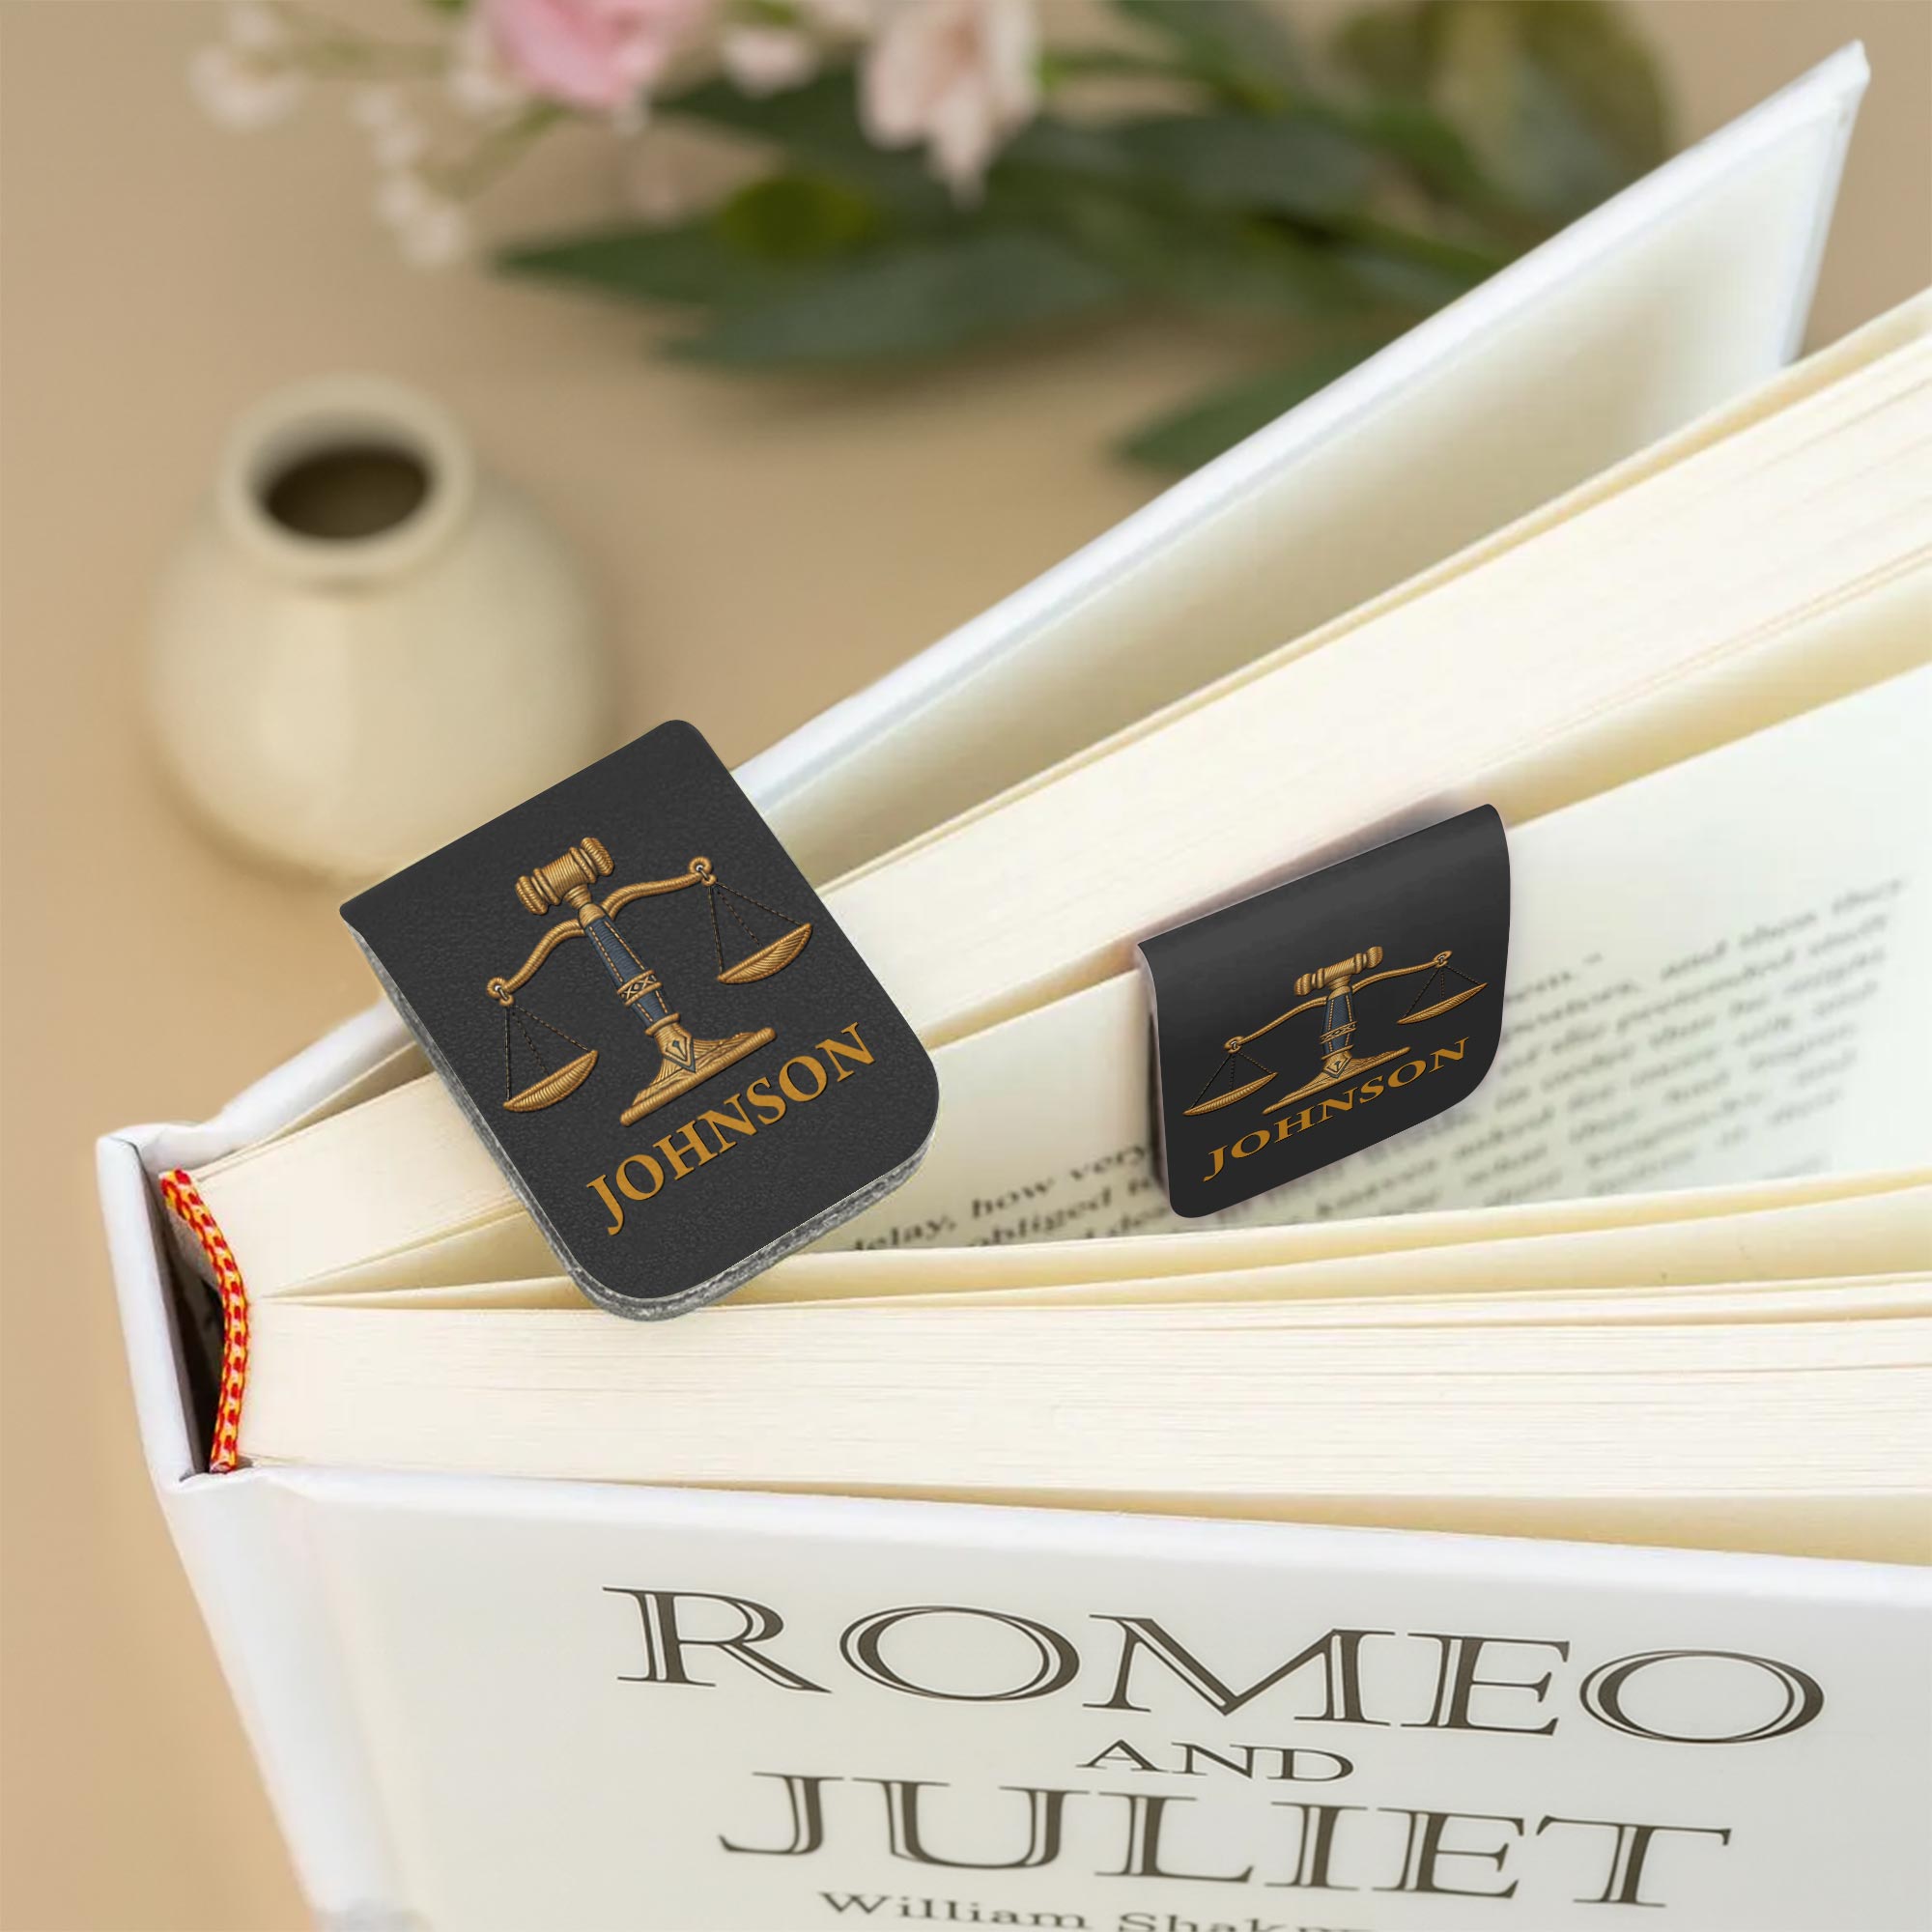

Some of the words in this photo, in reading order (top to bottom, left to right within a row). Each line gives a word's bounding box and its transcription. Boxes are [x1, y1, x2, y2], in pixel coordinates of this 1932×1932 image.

[585, 1022, 876, 1236] JOHNSON
[1203, 1037, 1469, 1183] JOHNSON
[971, 1177, 1057, 1220] how
[601, 1585, 1826, 1746] ROMEO
[1075, 1738, 1355, 1783] AND
[718, 1771, 1733, 1909] JULIET
[819, 1891, 1092, 1930] William
[1118, 1913, 1378, 1932] Shak
